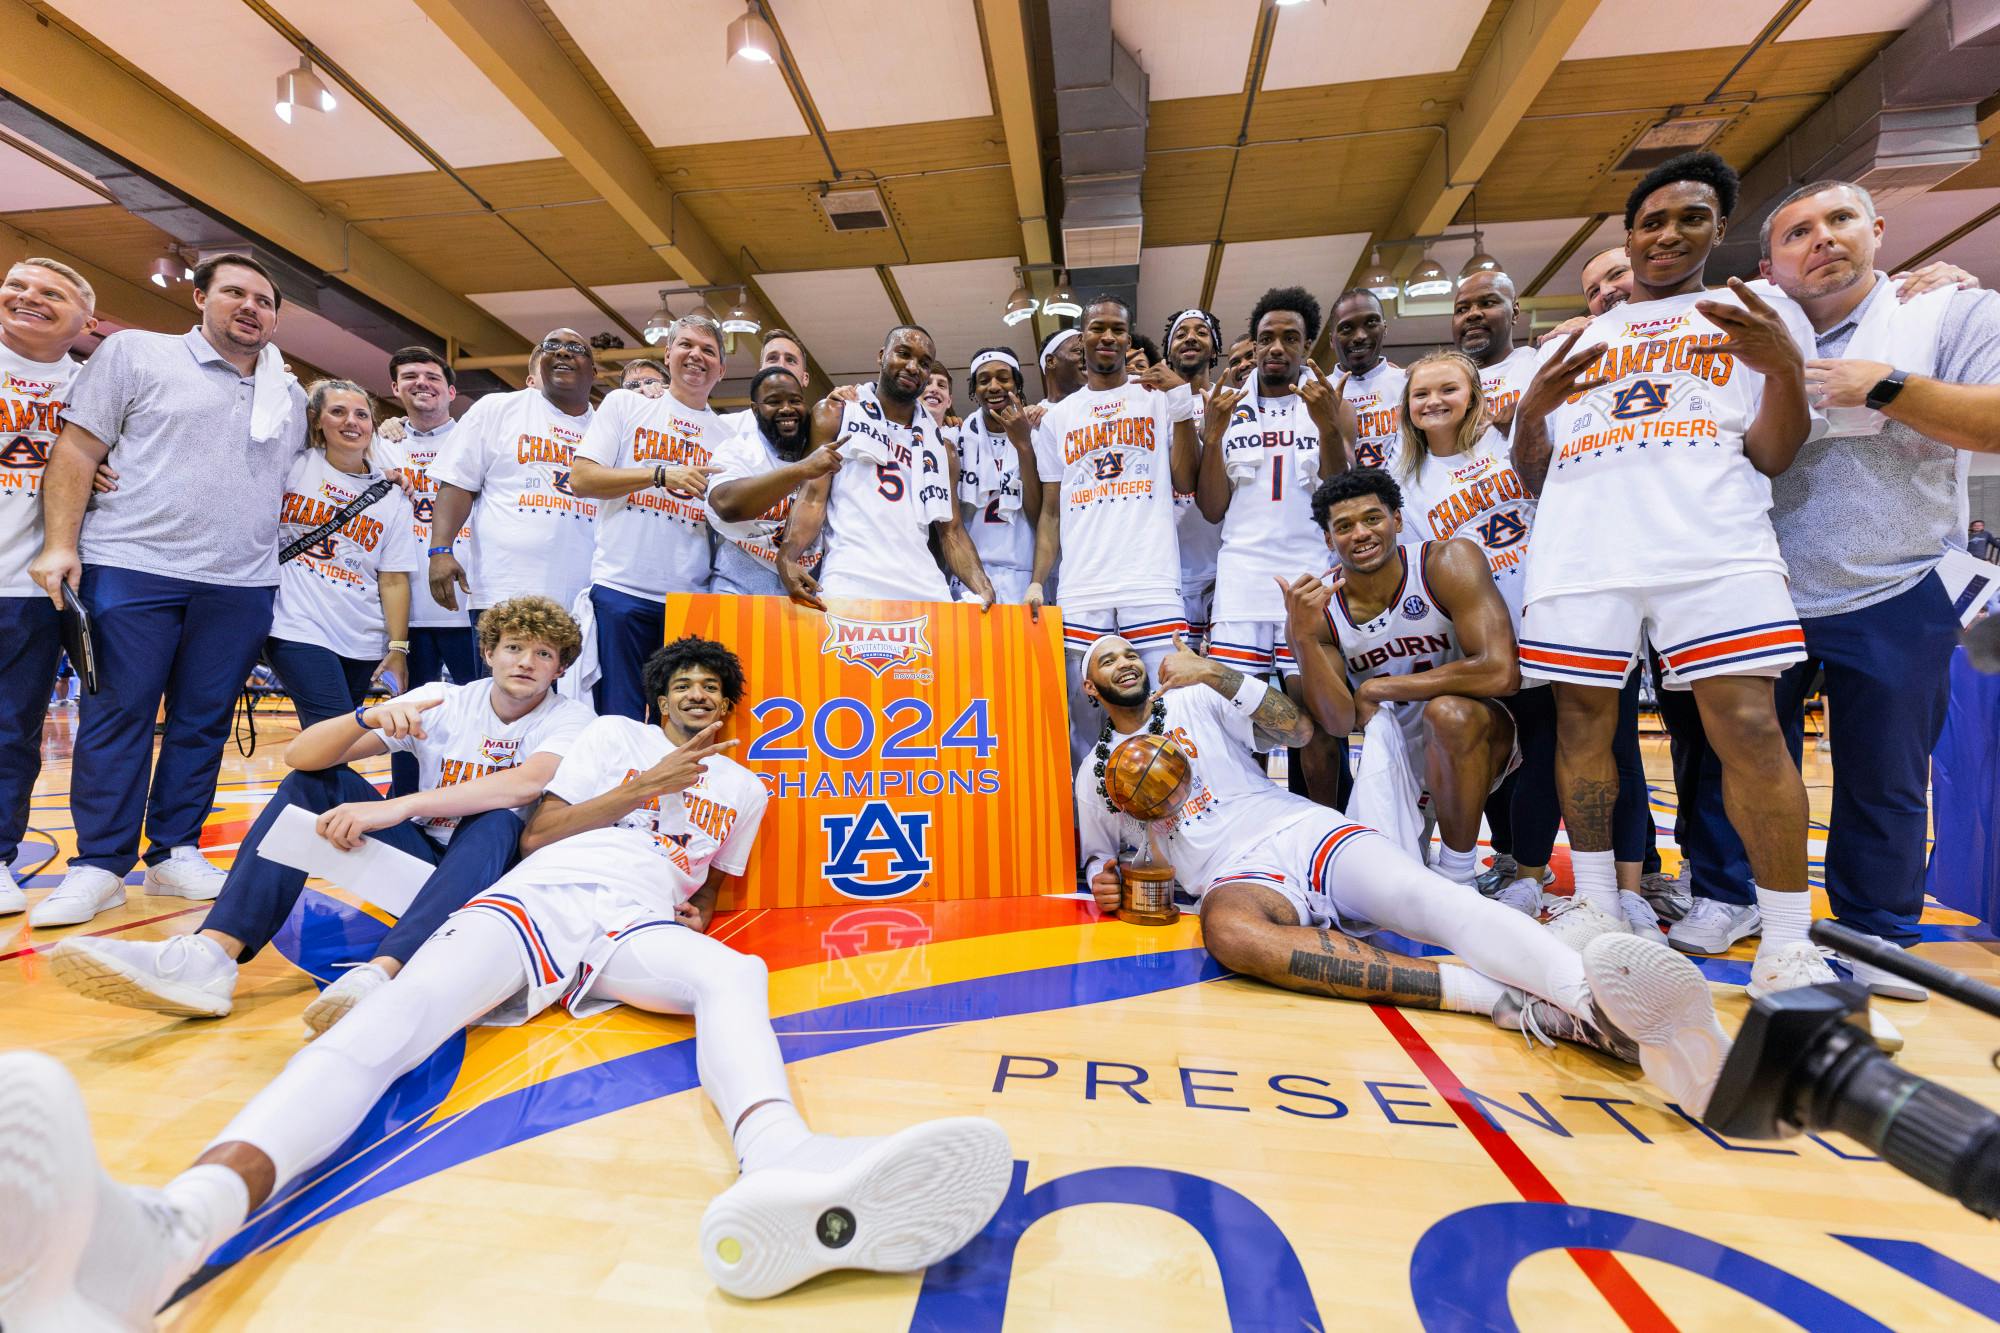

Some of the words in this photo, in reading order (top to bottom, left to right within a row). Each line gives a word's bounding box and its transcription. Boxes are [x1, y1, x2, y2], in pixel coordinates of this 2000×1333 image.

[1630, 316, 1683, 331] MAUI
[1094, 401, 1121, 412] MAUI
[553, 425, 583, 440] MAUI
[673, 418, 702, 433] MAUI
[1064, 416, 1156, 465] CHAMPIONS
[1558, 424, 1636, 461] AUBURN
[1641, 419, 1719, 439] TIGERS
[1454, 457, 1490, 478] MAUI
[876, 461, 905, 502] 5
[1110, 480, 1152, 495] TIGERS
[518, 494, 572, 511] AUBURN
[626, 491, 680, 515] AUBURN
[682, 503, 705, 522] TIGE
[300, 519, 341, 550] ARMOUR
[836, 623, 917, 644] MAUI
[853, 643, 902, 654] INVITATIONAL
[747, 696, 999, 762] 2024
[484, 740, 520, 750] MAUI
